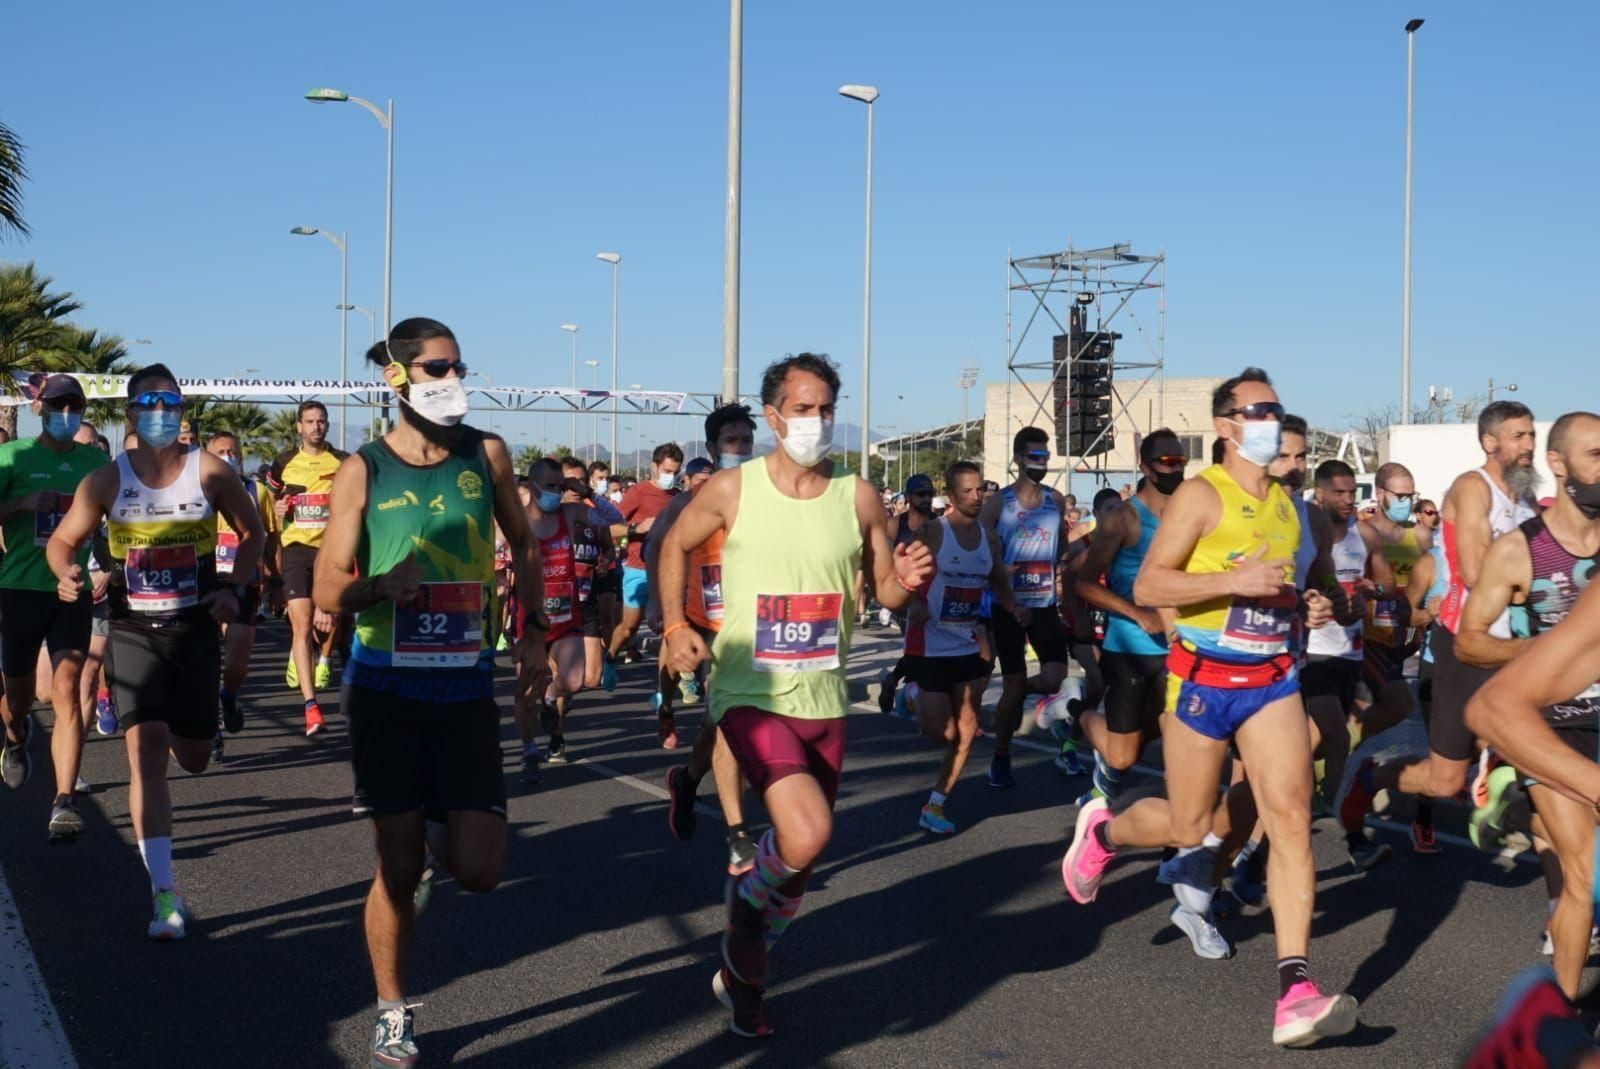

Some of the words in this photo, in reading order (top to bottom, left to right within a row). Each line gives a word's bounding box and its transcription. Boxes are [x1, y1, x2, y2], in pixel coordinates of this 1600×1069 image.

[178, 378, 208, 387] DIA
[302, 379, 388, 388] CAIXABAN
[297, 505, 321, 516] 1650
[138, 569, 172, 587] 128
[1020, 573, 1040, 584] 180
[418, 612, 448, 634] 32
[1243, 607, 1275, 626] 164
[770, 622, 812, 643] 169
